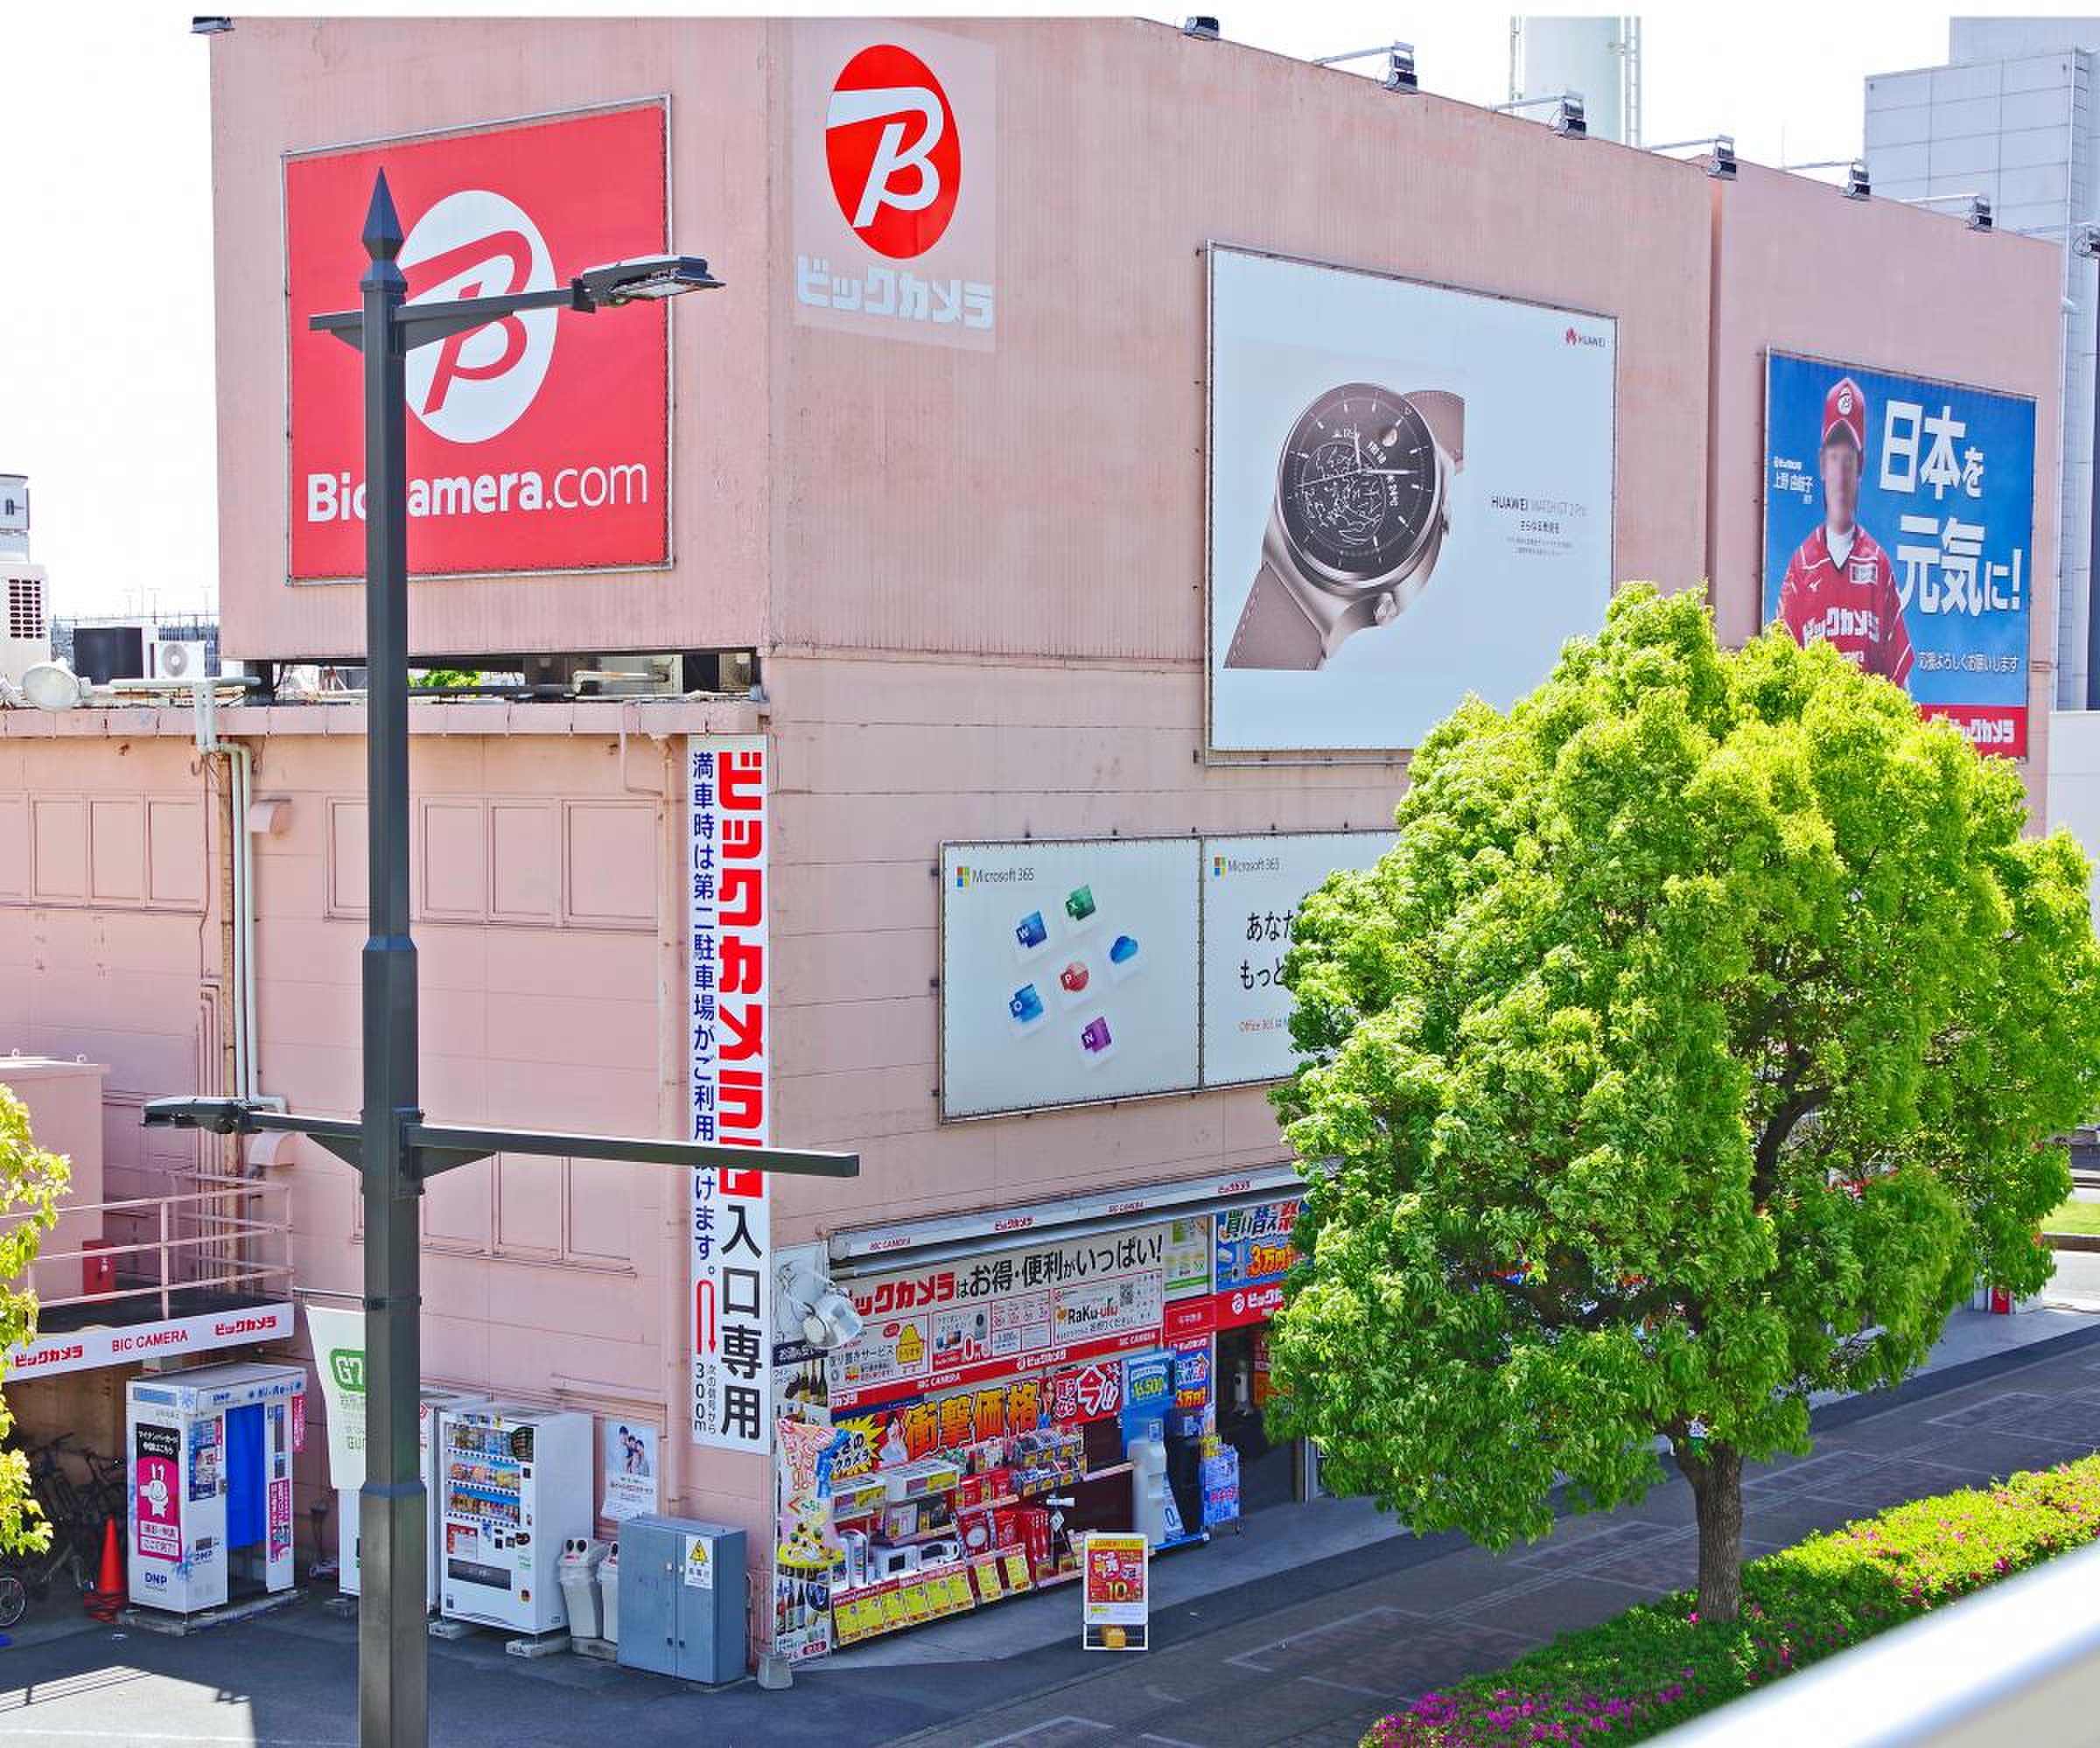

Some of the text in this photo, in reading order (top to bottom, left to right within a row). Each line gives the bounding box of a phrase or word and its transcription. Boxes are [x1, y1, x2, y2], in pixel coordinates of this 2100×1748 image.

[797, 255, 995, 331] ビックカメラ
[1880, 400, 1984, 500] 日本を
[307, 463, 648, 522] Bicamera.com
[1491, 495, 1528, 511] HUAWEI
[1897, 515, 2023, 617] 元気に!
[972, 867, 1035, 883] Microsoft 365
[718, 752, 764, 1129] ビックカメラ
[1240, 957, 1285, 990] もっと
[693, 752, 715, 1275] 満車時は第二駐車場がご利用けます。
[849, 1234, 1163, 1317] ックカメラはお得・便利がいっぱい!
[15, 1345, 83, 1367] ビックカメラ
[112, 1329, 188, 1353] BIC CAMERA
[215, 1316, 277, 1336] ビックカメラ
[719, 1204, 763, 1441] 入口専用
[694, 1362, 707, 1432] 300m
[906, 1381, 1039, 1460] 衝撃価格
[144, 1571, 167, 1586] DNP
